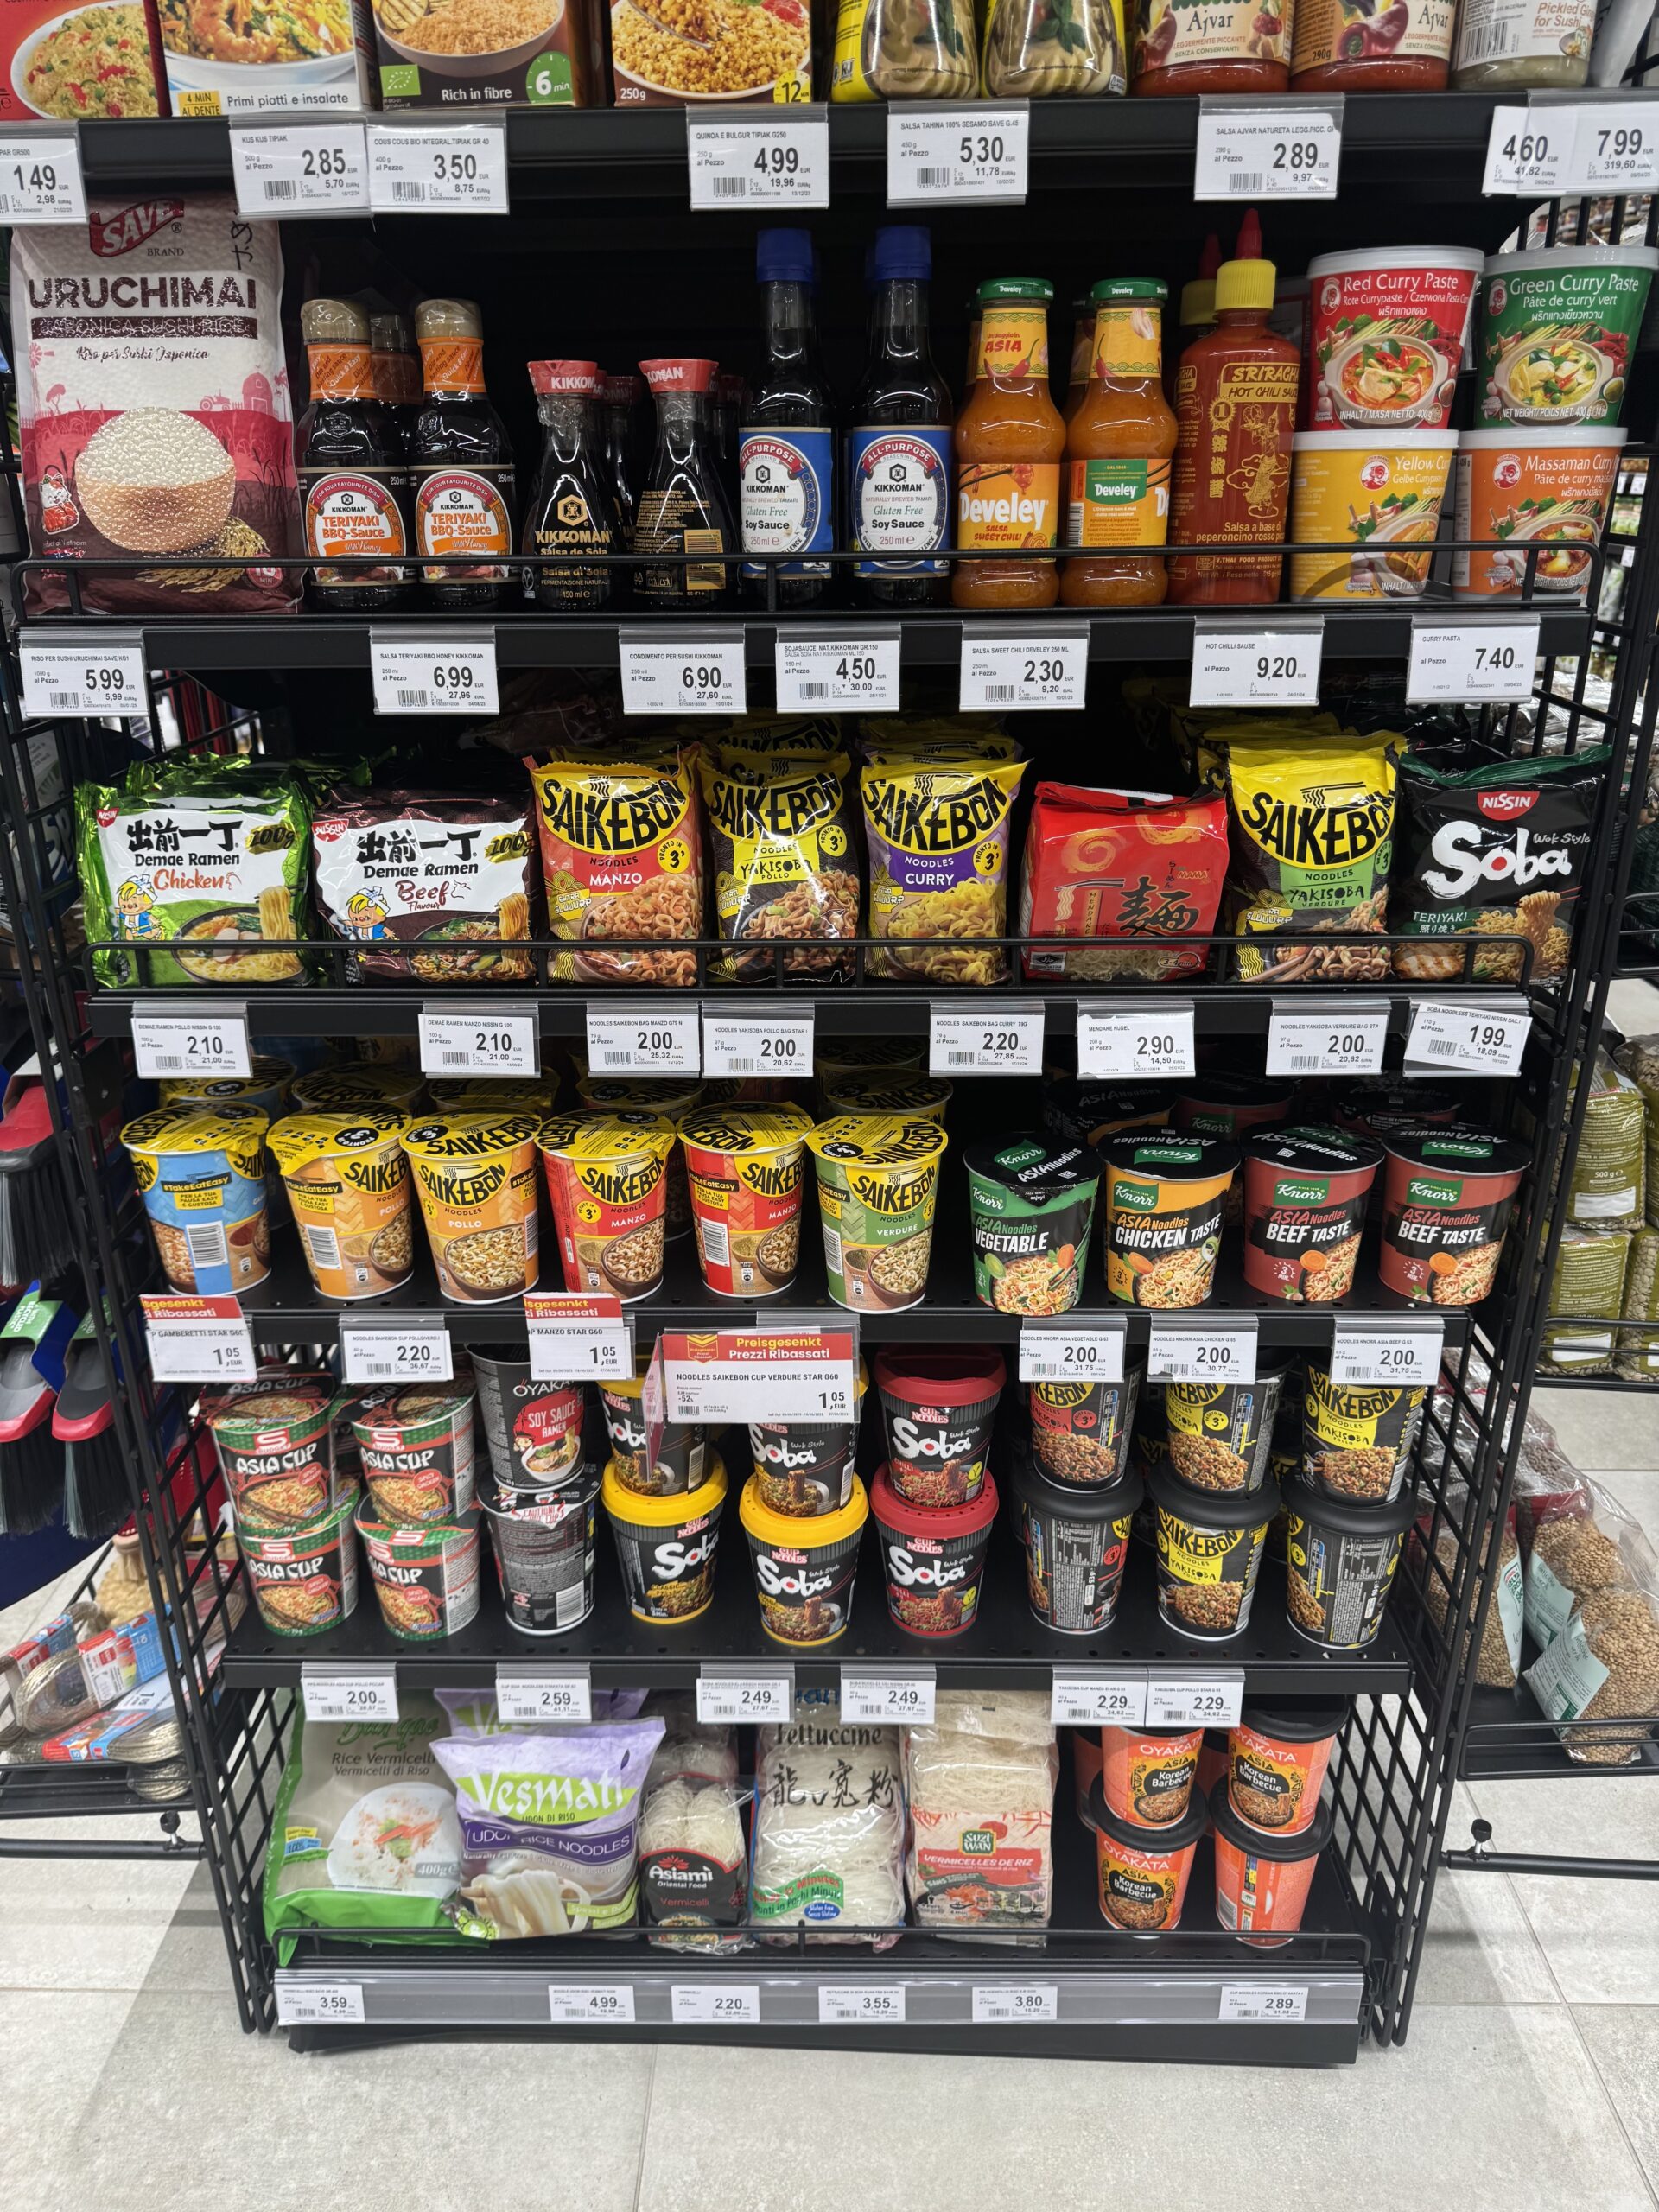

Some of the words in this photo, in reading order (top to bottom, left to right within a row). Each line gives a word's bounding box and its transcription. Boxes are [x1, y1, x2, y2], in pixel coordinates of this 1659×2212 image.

[1186, 10, 1234, 36] Ajvar
[1173, 37, 1216, 49] LEGGERMENTE
[1217, 35, 1246, 46] PICCANTE
[227, 94, 253, 107] Primi
[257, 93, 287, 108] piatti
[302, 92, 348, 105] insalate
[442, 88, 463, 101] Rich
[467, 88, 477, 100] in
[480, 86, 512, 99] fibre
[620, 87, 645, 102] 250g
[696, 131, 718, 140] QUINOA
[1597, 128, 1642, 160] 7,99
[960, 137, 1003, 166] 5,30
[1273, 143, 1318, 172] 2,89
[302, 149, 346, 178] 2,85
[434, 154, 476, 183] 3,50
[754, 147, 798, 176] 4,99
[147, 247, 185, 257] BRAND
[29, 276, 257, 309] URUCHIMAI
[1344, 275, 1370, 292] Red
[1375, 274, 1420, 292] Curry
[1425, 275, 1458, 289] Paste
[1510, 276, 1554, 295] Green
[1560, 275, 1605, 295] Curry
[1608, 275, 1639, 292] Paste
[1523, 296, 1542, 308] Pâte
[1545, 296, 1557, 306] de
[1560, 298, 1591, 308] curry
[1598, 295, 1618, 305] vert
[985, 340, 1021, 353] ASIA
[1228, 386, 1254, 397] HOT
[1255, 386, 1283, 397] CHILI
[867, 443, 931, 462] ALL-PURPOSE
[1396, 456, 1433, 471] Yellow
[1525, 455, 1589, 472] Massaman
[1593, 455, 1613, 474] Curry
[874, 484, 922, 493] KIKKOMAN
[874, 505, 900, 516] Gluten
[903, 505, 923, 515] Free
[961, 493, 1046, 530] Develey
[322, 517, 380, 528] TERIYAKI
[872, 520, 890, 531] Soy
[892, 519, 925, 529] Sauce
[1224, 521, 1248, 532] Salsa
[1258, 521, 1274, 531] base
[322, 528, 385, 539] BBQ-Sauce
[536, 531, 610, 544] KIKKOMAN
[974, 532, 1001, 541] SWEET
[1196, 532, 1251, 543] peperoncino
[1253, 531, 1274, 542] rosso
[1257, 656, 1297, 680] 9,20
[1475, 647, 1514, 671] 7,40
[86, 669, 124, 691] 5,99
[433, 665, 473, 690] 6,99
[682, 666, 721, 690] 6,90
[836, 658, 875, 683] 4,50
[1024, 660, 1064, 683] 2,30
[710, 772, 844, 842] SAIKEBON
[1482, 794, 1531, 810] NISSIN
[541, 777, 685, 851] SAIKEBON
[861, 774, 1007, 852] SAIKEBON
[126, 817, 243, 855] 出前一丁
[249, 823, 296, 848] 100g
[1533, 833, 1559, 847] Wok
[1561, 832, 1591, 847] Style
[134, 853, 184, 866] Demae
[188, 852, 239, 865] Ramen
[740, 857, 810, 880] YAKISOBA
[905, 855, 954, 868] NOODLES
[1421, 821, 1572, 899] Soba
[153, 868, 225, 891] Chicken
[589, 873, 642, 887] MANZO
[761, 872, 789, 880] POLLO
[906, 873, 954, 887] CURRY
[1305, 868, 1353, 882] NOODLES
[396, 880, 448, 901] Beef
[1288, 885, 1364, 905] YAKISOBA
[1301, 899, 1346, 910] VERDURE
[1413, 912, 1467, 923] TERIYAKI
[187, 1036, 223, 1055] 2,10
[637, 1032, 672, 1052] 2,00
[983, 1032, 1018, 1052] 2,20
[1136, 1035, 1174, 1057] 2,90
[1469, 1025, 1504, 1048] 1,99
[163, 1177, 230, 1191] #TakeEatEasy
[417, 1163, 505, 1205] SAIKEBON
[582, 1158, 664, 1204] SAIKEBON
[852, 1166, 935, 1211] SAIKEBON
[971, 1185, 1004, 1211] Knorr
[1114, 1186, 1156, 1209] Knorr
[1276, 1182, 1325, 1203] Knorr
[611, 1213, 647, 1228] MANZO
[880, 1211, 917, 1223] NOODLES
[1117, 1214, 1152, 1230] ASIA
[1152, 1217, 1189, 1230] Noodles
[877, 1224, 918, 1236] VERDURE
[1115, 1227, 1187, 1247] CHICKEN
[1190, 1215, 1220, 1243] TASTE
[1266, 1222, 1308, 1242] BEEF
[1312, 1220, 1351, 1240] TASTE
[974, 1230, 1049, 1253] VEGETABLE
[736, 1337, 821, 1350] Preisgesenkt
[397, 1345, 430, 1364] 2,20
[729, 1350, 766, 1360] Prezzi
[769, 1349, 830, 1359] Ribassati
[1064, 1346, 1098, 1364] 2,00
[1381, 1350, 1414, 1367] 2,00
[528, 1411, 548, 1428] SOY
[550, 1403, 575, 1422] SAUCE
[542, 1422, 567, 1438] RAMEN
[893, 1417, 972, 1460] Soba
[236, 1452, 283, 1474] ASIA
[282, 1443, 317, 1466] CUP
[757, 1555, 832, 1598] Soba
[542, 1691, 571, 1707] 2,59
[742, 1690, 772, 1706] 2,49
[332, 1753, 361, 1764] Rice
[366, 1751, 435, 1765] Vermicelli
[469, 1767, 623, 1812] Vesmati
[925, 1854, 997, 1866] VERMICELLES
[1015, 1859, 1033, 1867] RIZ
[1115, 1879, 1157, 1899] Barbecue
[1119, 1877, 1152, 1892] Korean
[590, 1997, 617, 2011] 4,99
[863, 1997, 890, 2011] 3,55
[1266, 1998, 1293, 2012] 2,89
